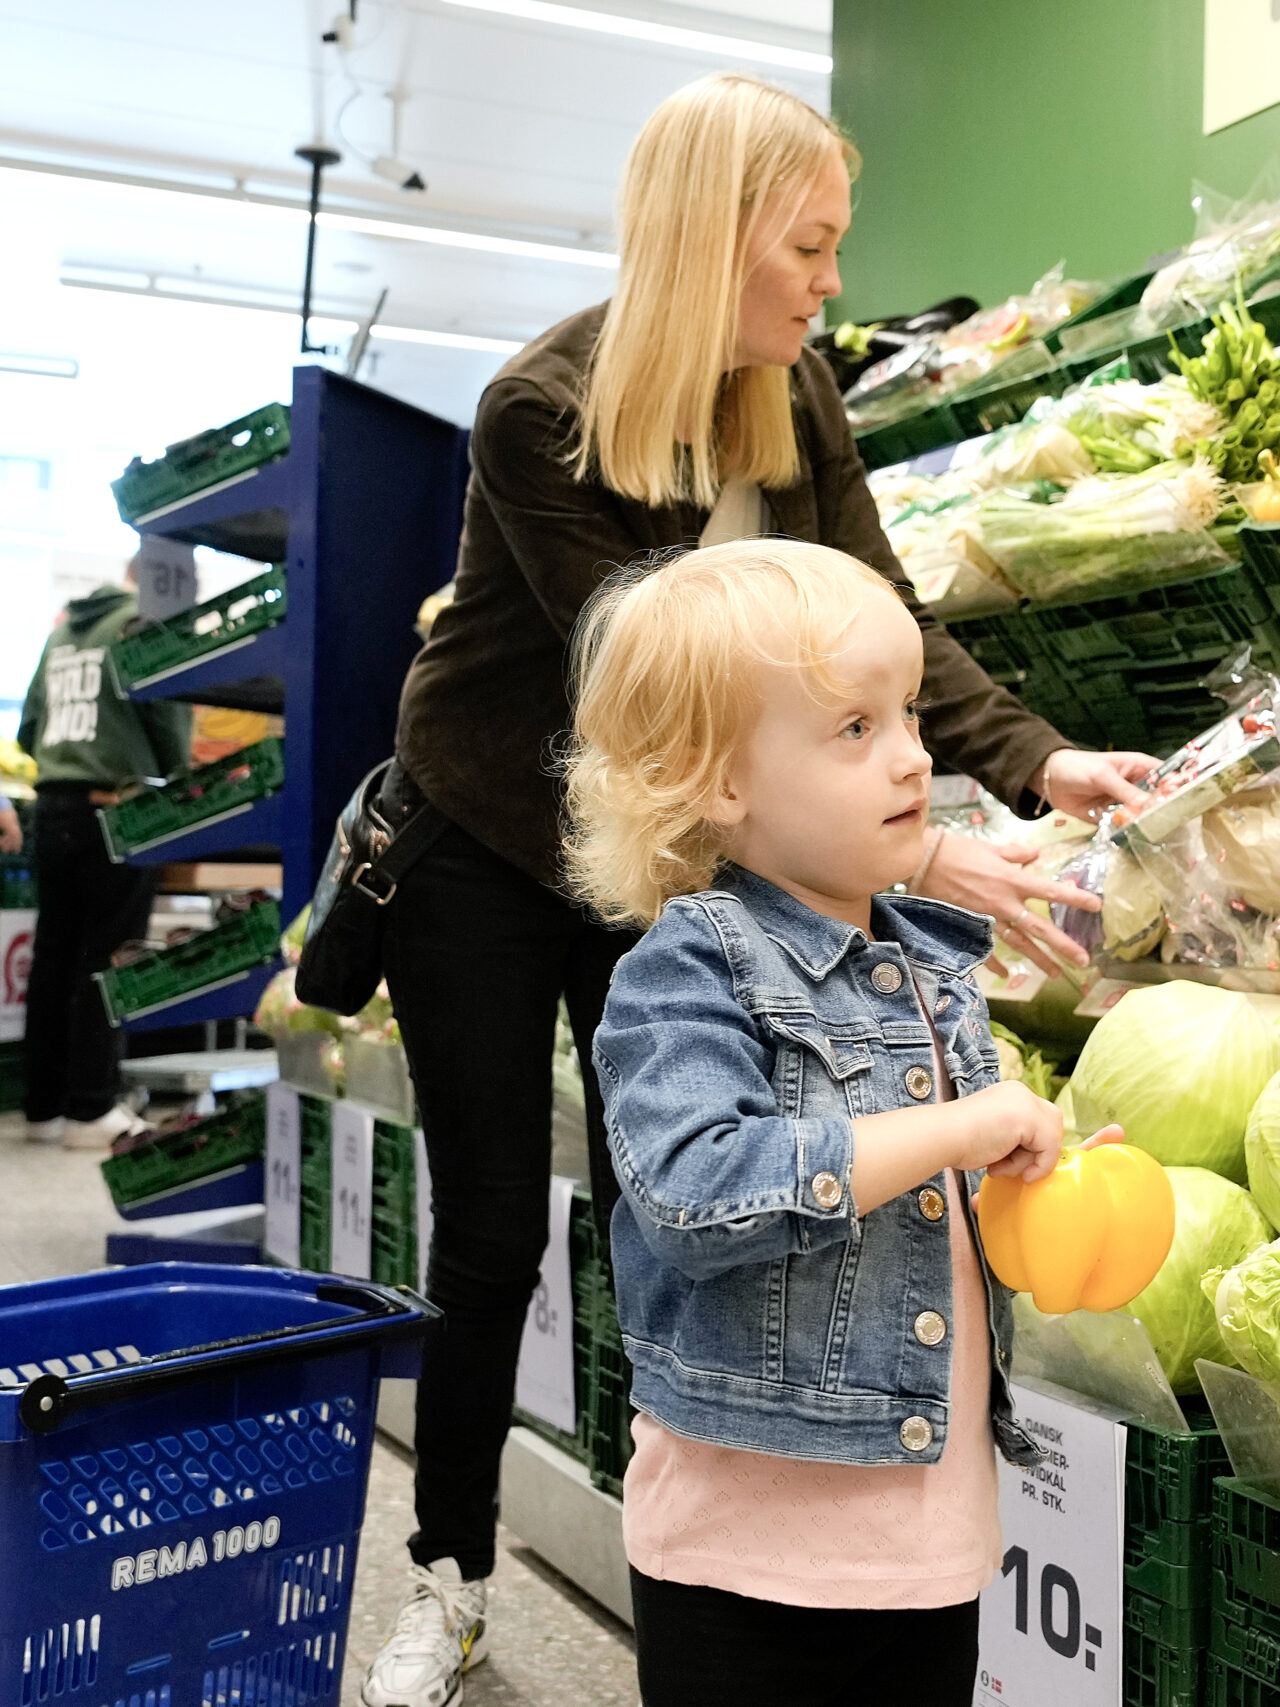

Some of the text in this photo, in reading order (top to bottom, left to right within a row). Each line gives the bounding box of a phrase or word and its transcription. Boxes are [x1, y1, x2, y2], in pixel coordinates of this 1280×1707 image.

[1025, 1417, 1064, 1446] DANSK
[1022, 1481, 1066, 1514] PR. STK.
[111, 1515, 281, 1591] REMA 1000
